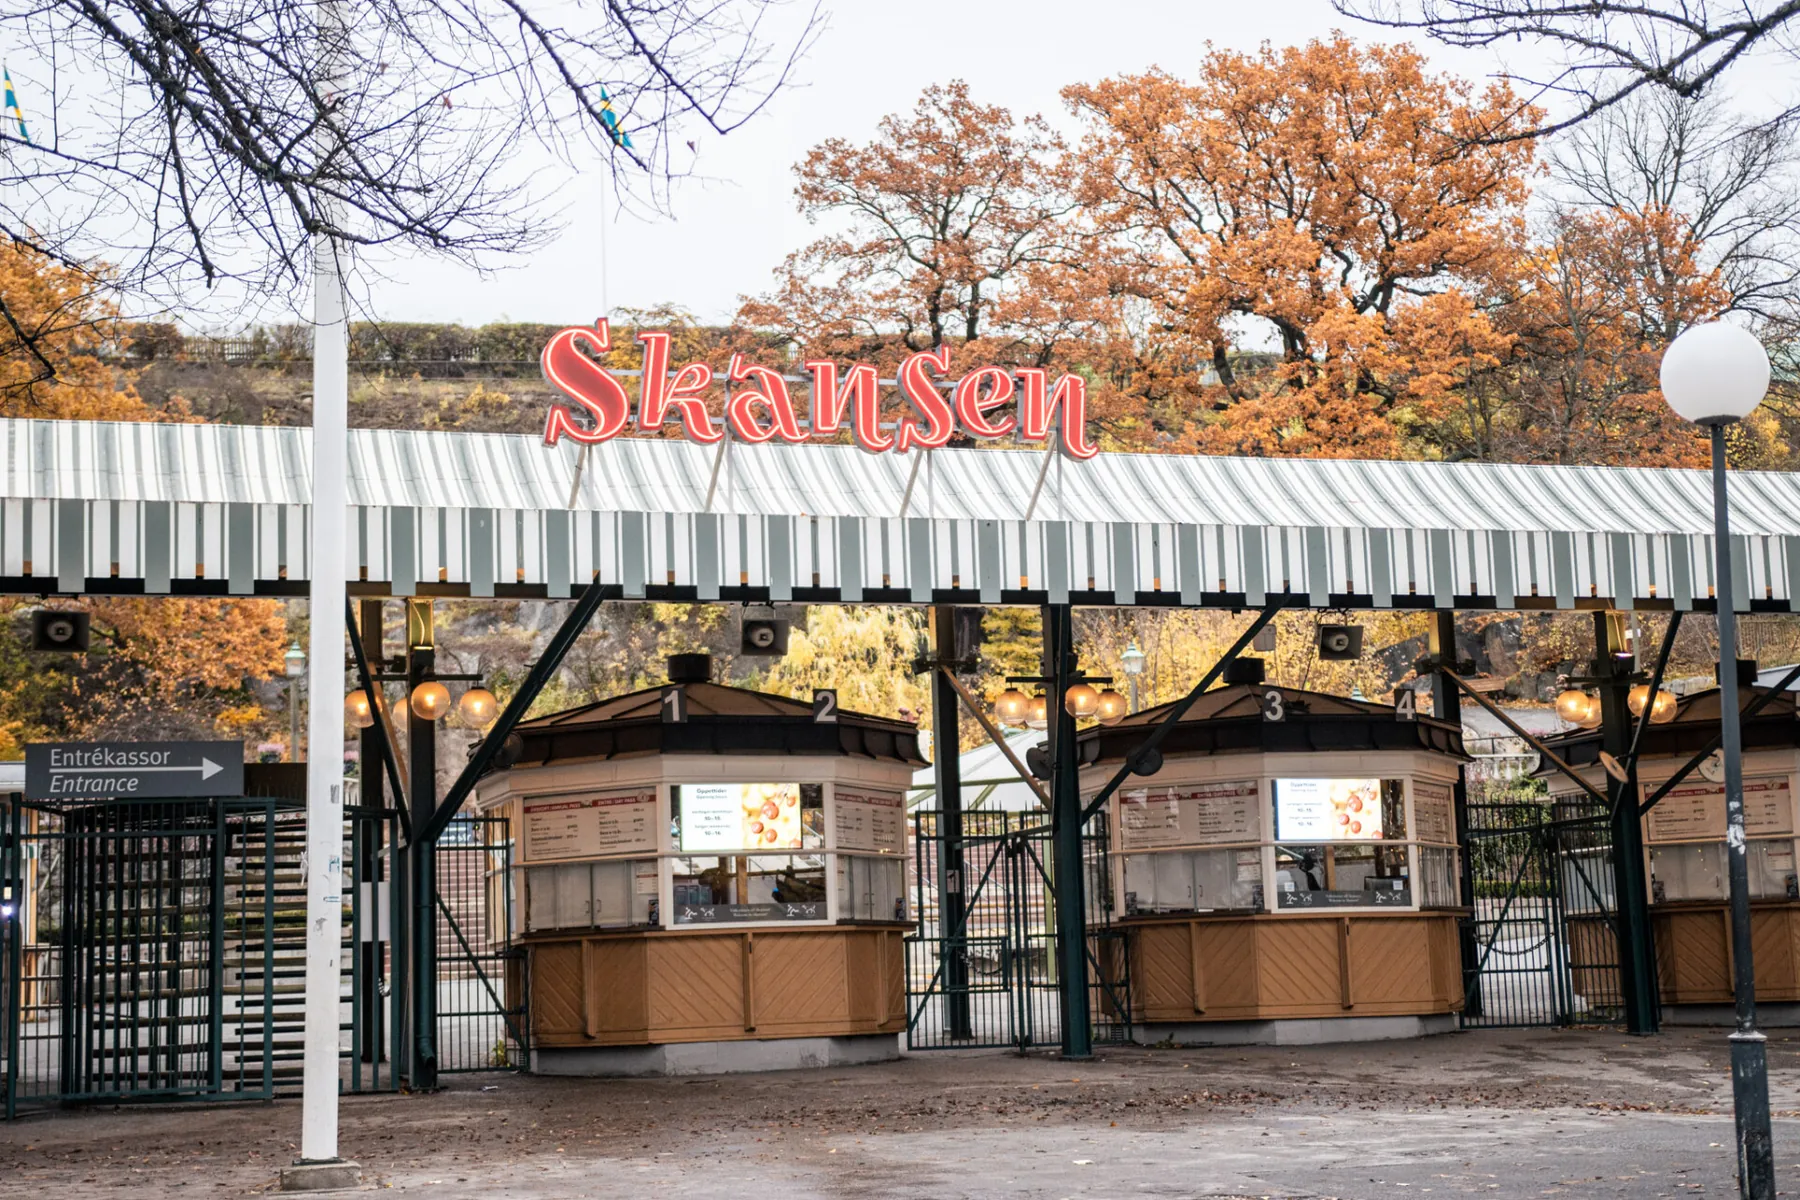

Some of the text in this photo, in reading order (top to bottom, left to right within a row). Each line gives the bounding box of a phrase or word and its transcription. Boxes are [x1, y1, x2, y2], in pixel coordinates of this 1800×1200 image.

[541, 317, 1099, 462] Skansen
[664, 689, 680, 722] 1
[815, 690, 837, 722] 2
[1264, 690, 1284, 721] 3
[1396, 690, 1416, 720] 4
[50, 747, 171, 767] Entrékassor
[49, 775, 139, 793] Entrance
